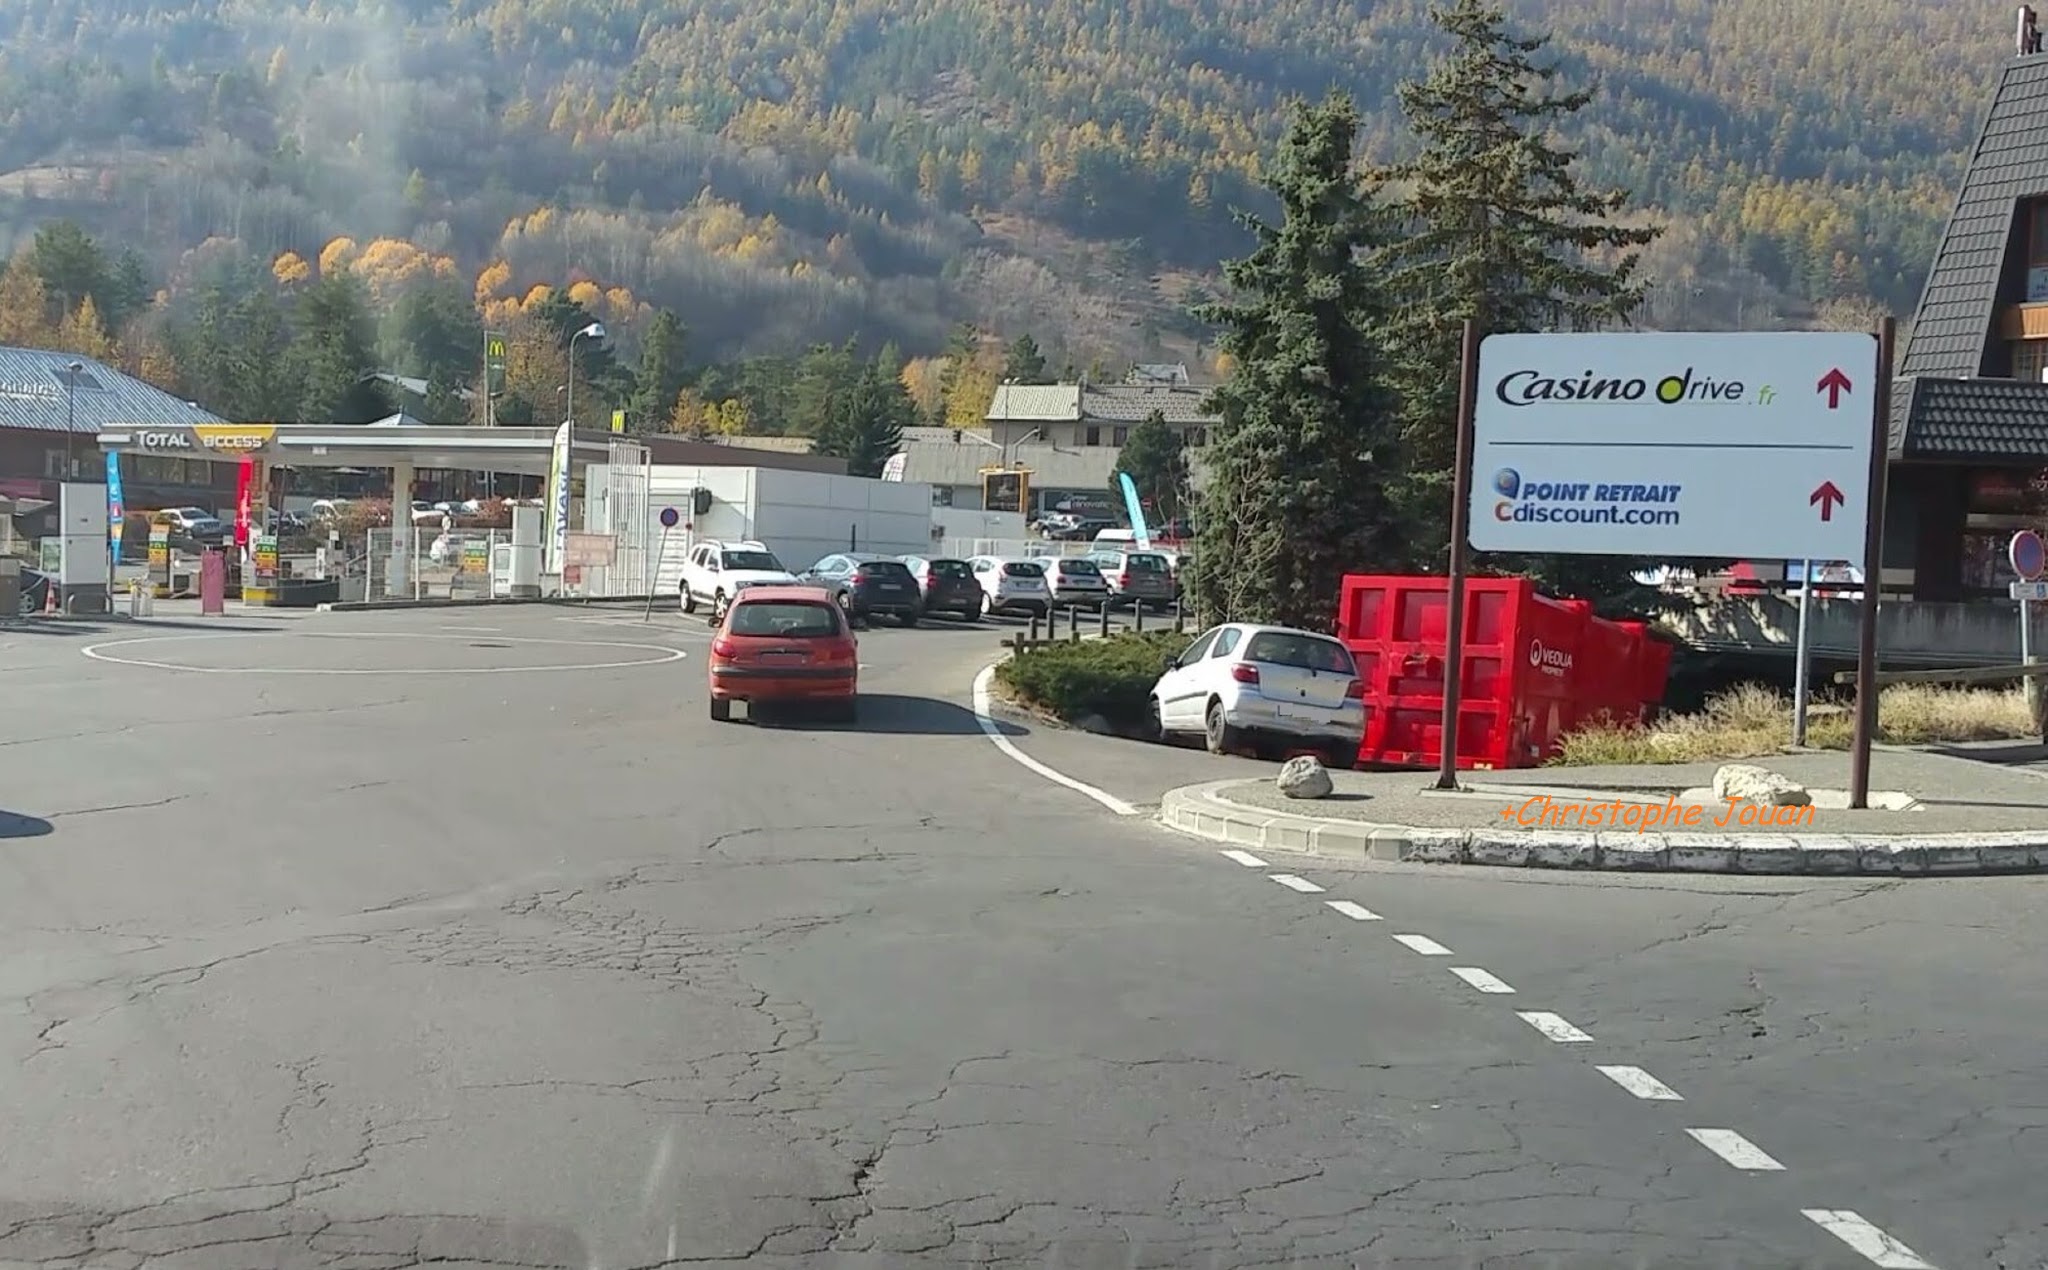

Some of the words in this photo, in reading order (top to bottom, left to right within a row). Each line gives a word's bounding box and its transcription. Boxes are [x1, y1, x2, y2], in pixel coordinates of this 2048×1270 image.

[1495, 369, 1647, 407] Casino
[137, 431, 190, 448] TOTAL
[1522, 482, 1590, 502] POINT
[1593, 483, 1682, 503] RETRAIT
[1494, 501, 1681, 526] Cdiscount.com
[1542, 648, 1573, 670] VEOLIA
